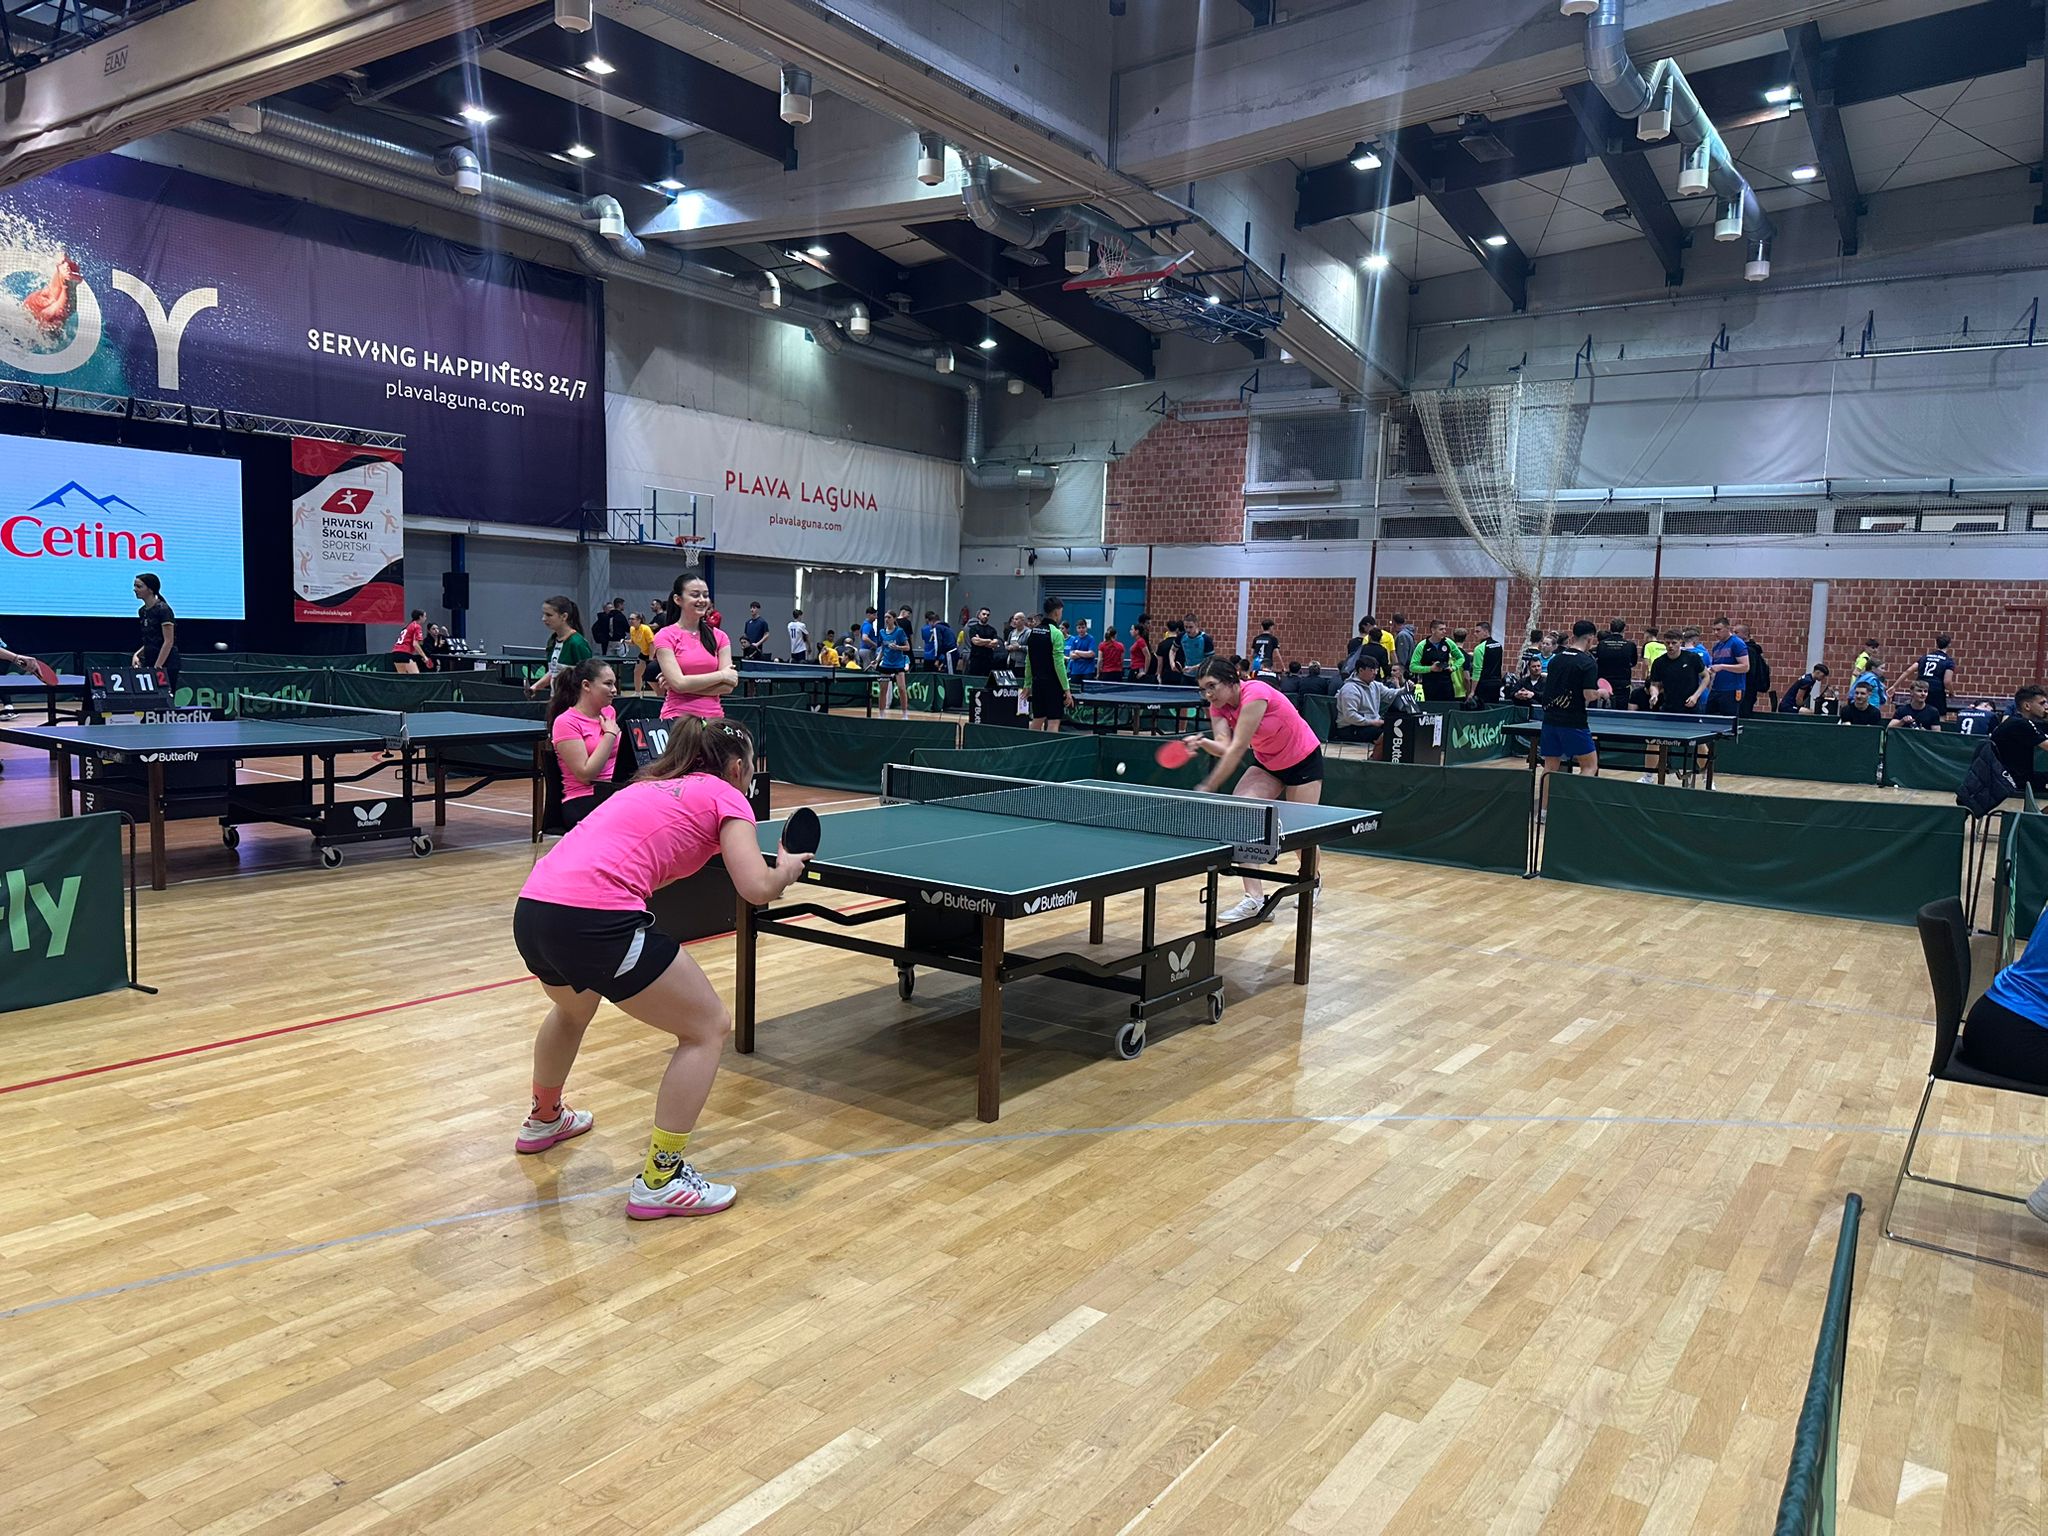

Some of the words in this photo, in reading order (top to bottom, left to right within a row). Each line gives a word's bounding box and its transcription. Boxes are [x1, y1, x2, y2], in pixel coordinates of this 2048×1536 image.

[104, 49, 129, 73] ELAN
[307, 328, 417, 368] SERVING
[423, 350, 545, 392] HAPPINESS
[549, 375, 588, 402] 24/7
[386, 379, 525, 417] plavalaguna.com
[725, 470, 791, 500] PLAVA
[801, 482, 878, 513] LAGUNA
[322, 517, 373, 529] HRVATSKI
[769, 513, 842, 532] plavalaguna.com
[0, 515, 166, 562] Cetina
[322, 527, 367, 540] ŠKOLSKI
[322, 540, 371, 551] SPORTSKI
[322, 551, 355, 561] SAVEZ
[1923, 661, 1937, 677] 12
[111, 674, 125, 692] 2
[136, 673, 155, 691] 11
[633, 728, 648, 749] 2
[649, 728, 670, 755] 10
[158, 752, 199, 763] Butterfly
[357, 818, 381, 828] Butterfly
[1245, 846, 1270, 856] JOOLA
[944, 892, 997, 916] Butterfly
[1040, 889, 1078, 911] Butterfly
